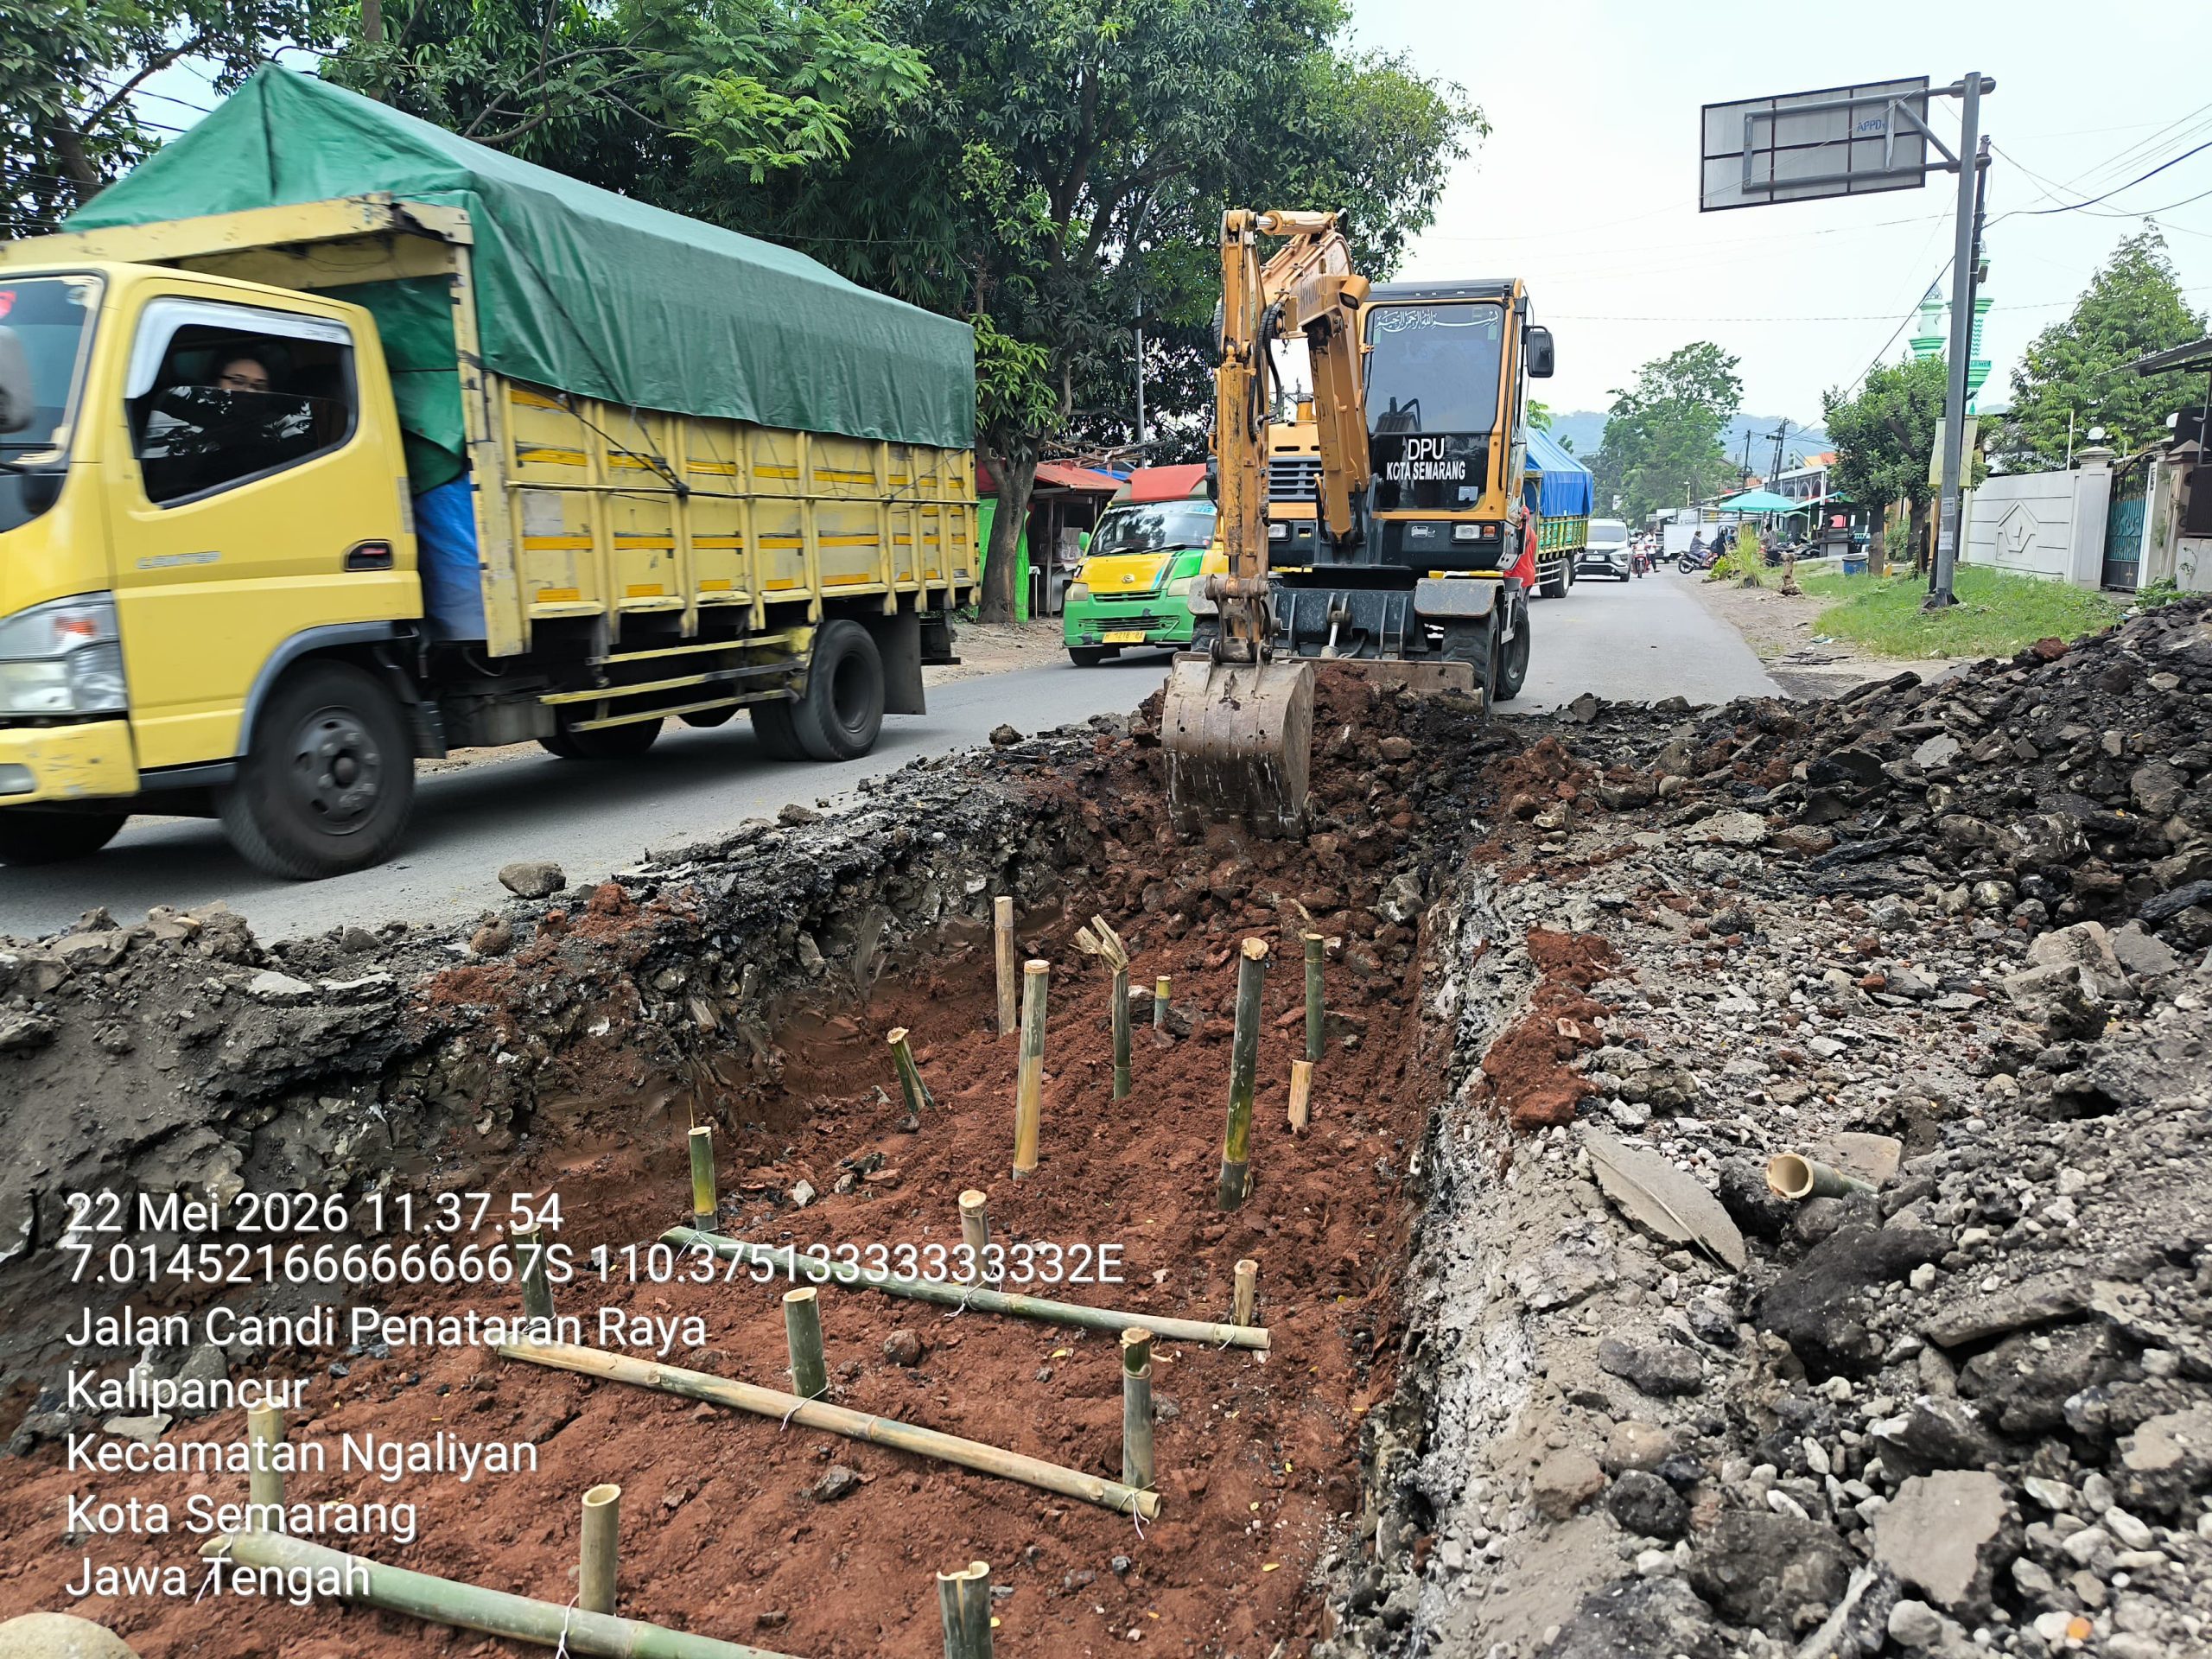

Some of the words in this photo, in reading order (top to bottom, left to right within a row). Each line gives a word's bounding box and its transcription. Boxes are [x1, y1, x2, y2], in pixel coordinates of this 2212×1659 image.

[1408, 438, 1445, 461] DPU
[1386, 461, 1411, 481] KOTA
[1412, 461, 1466, 480] SEMARANG
